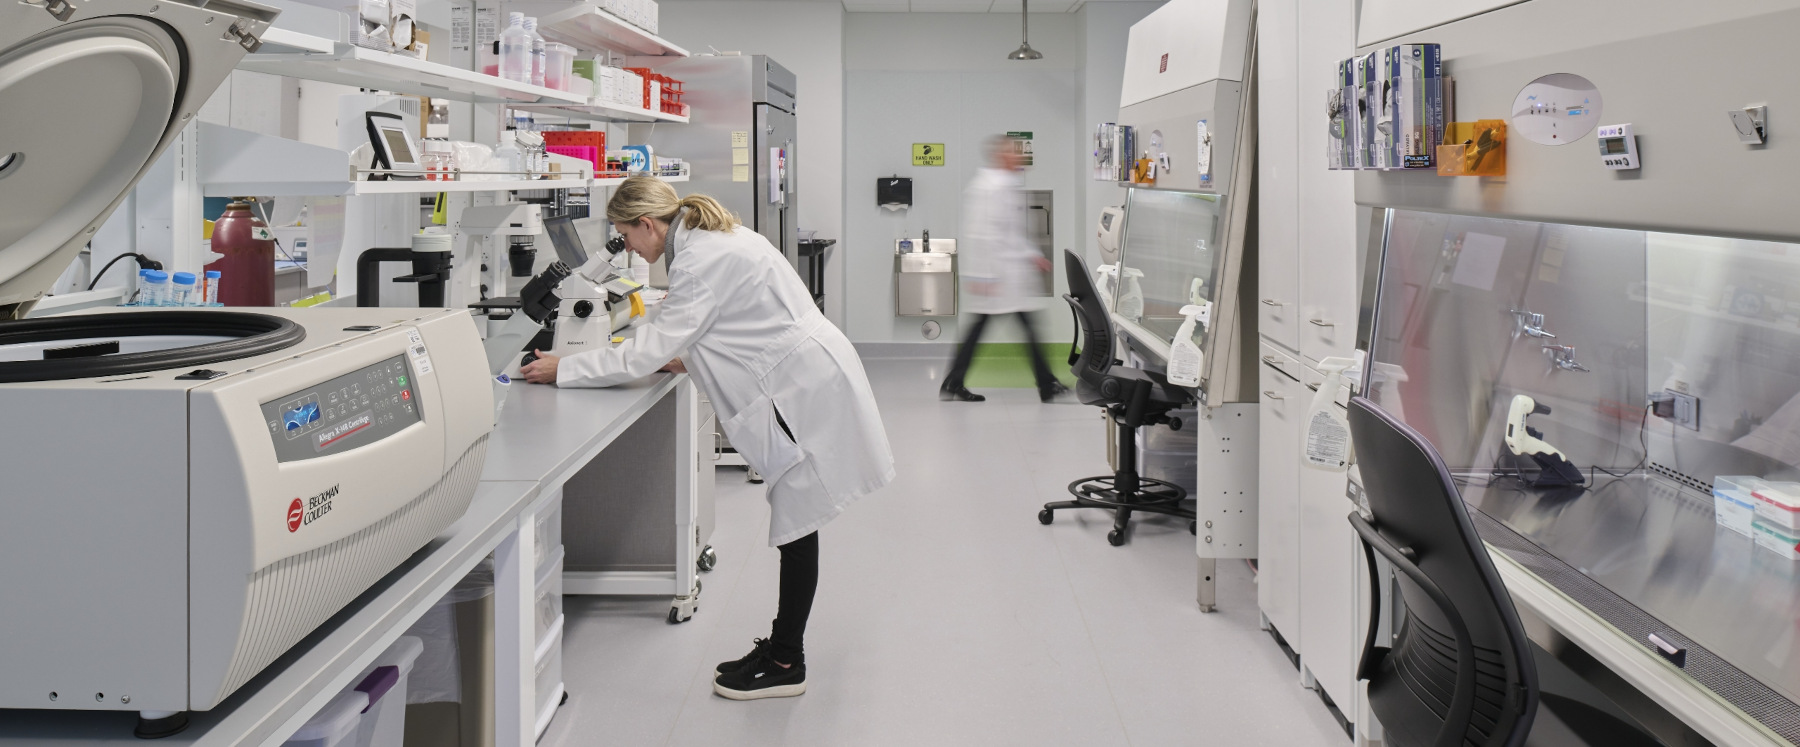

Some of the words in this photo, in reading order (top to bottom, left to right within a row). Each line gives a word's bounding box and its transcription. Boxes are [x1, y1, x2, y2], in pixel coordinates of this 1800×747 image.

[319, 431, 335, 443] Allegra
[348, 415, 370, 429] Centrifuge
[309, 482, 340, 511] BECKMAN
[303, 500, 332, 526] COULTER
